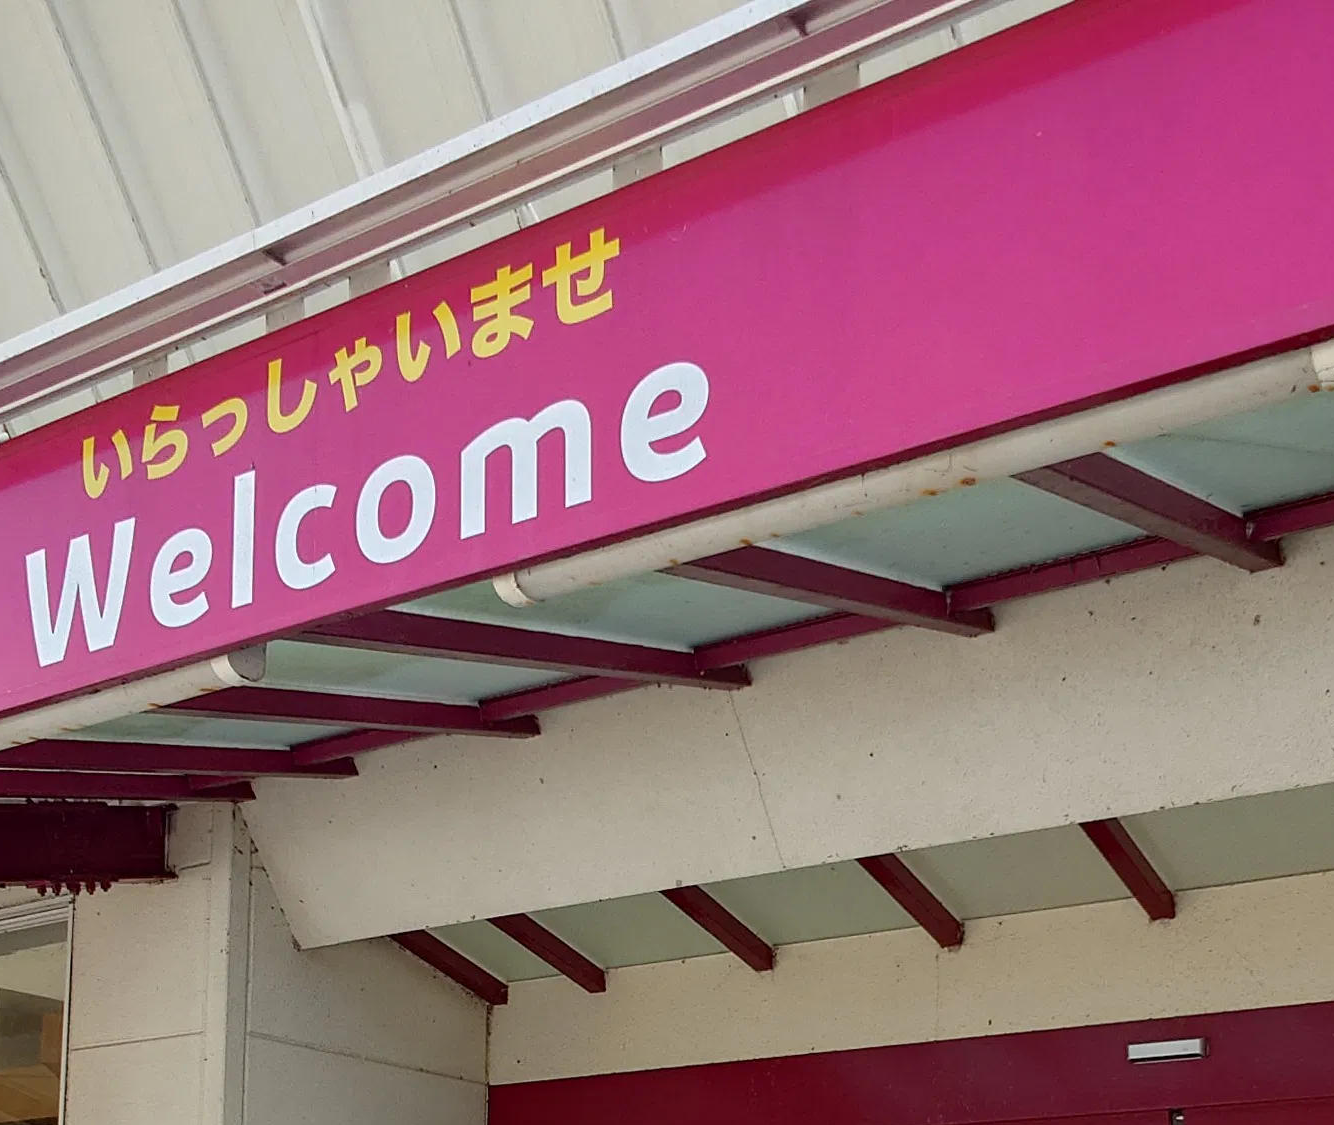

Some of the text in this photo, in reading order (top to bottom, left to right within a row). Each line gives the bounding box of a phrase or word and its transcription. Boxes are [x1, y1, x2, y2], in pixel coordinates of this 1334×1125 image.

[82, 227, 620, 498] いらっしゃいませ
[25, 362, 710, 667] Welcome
